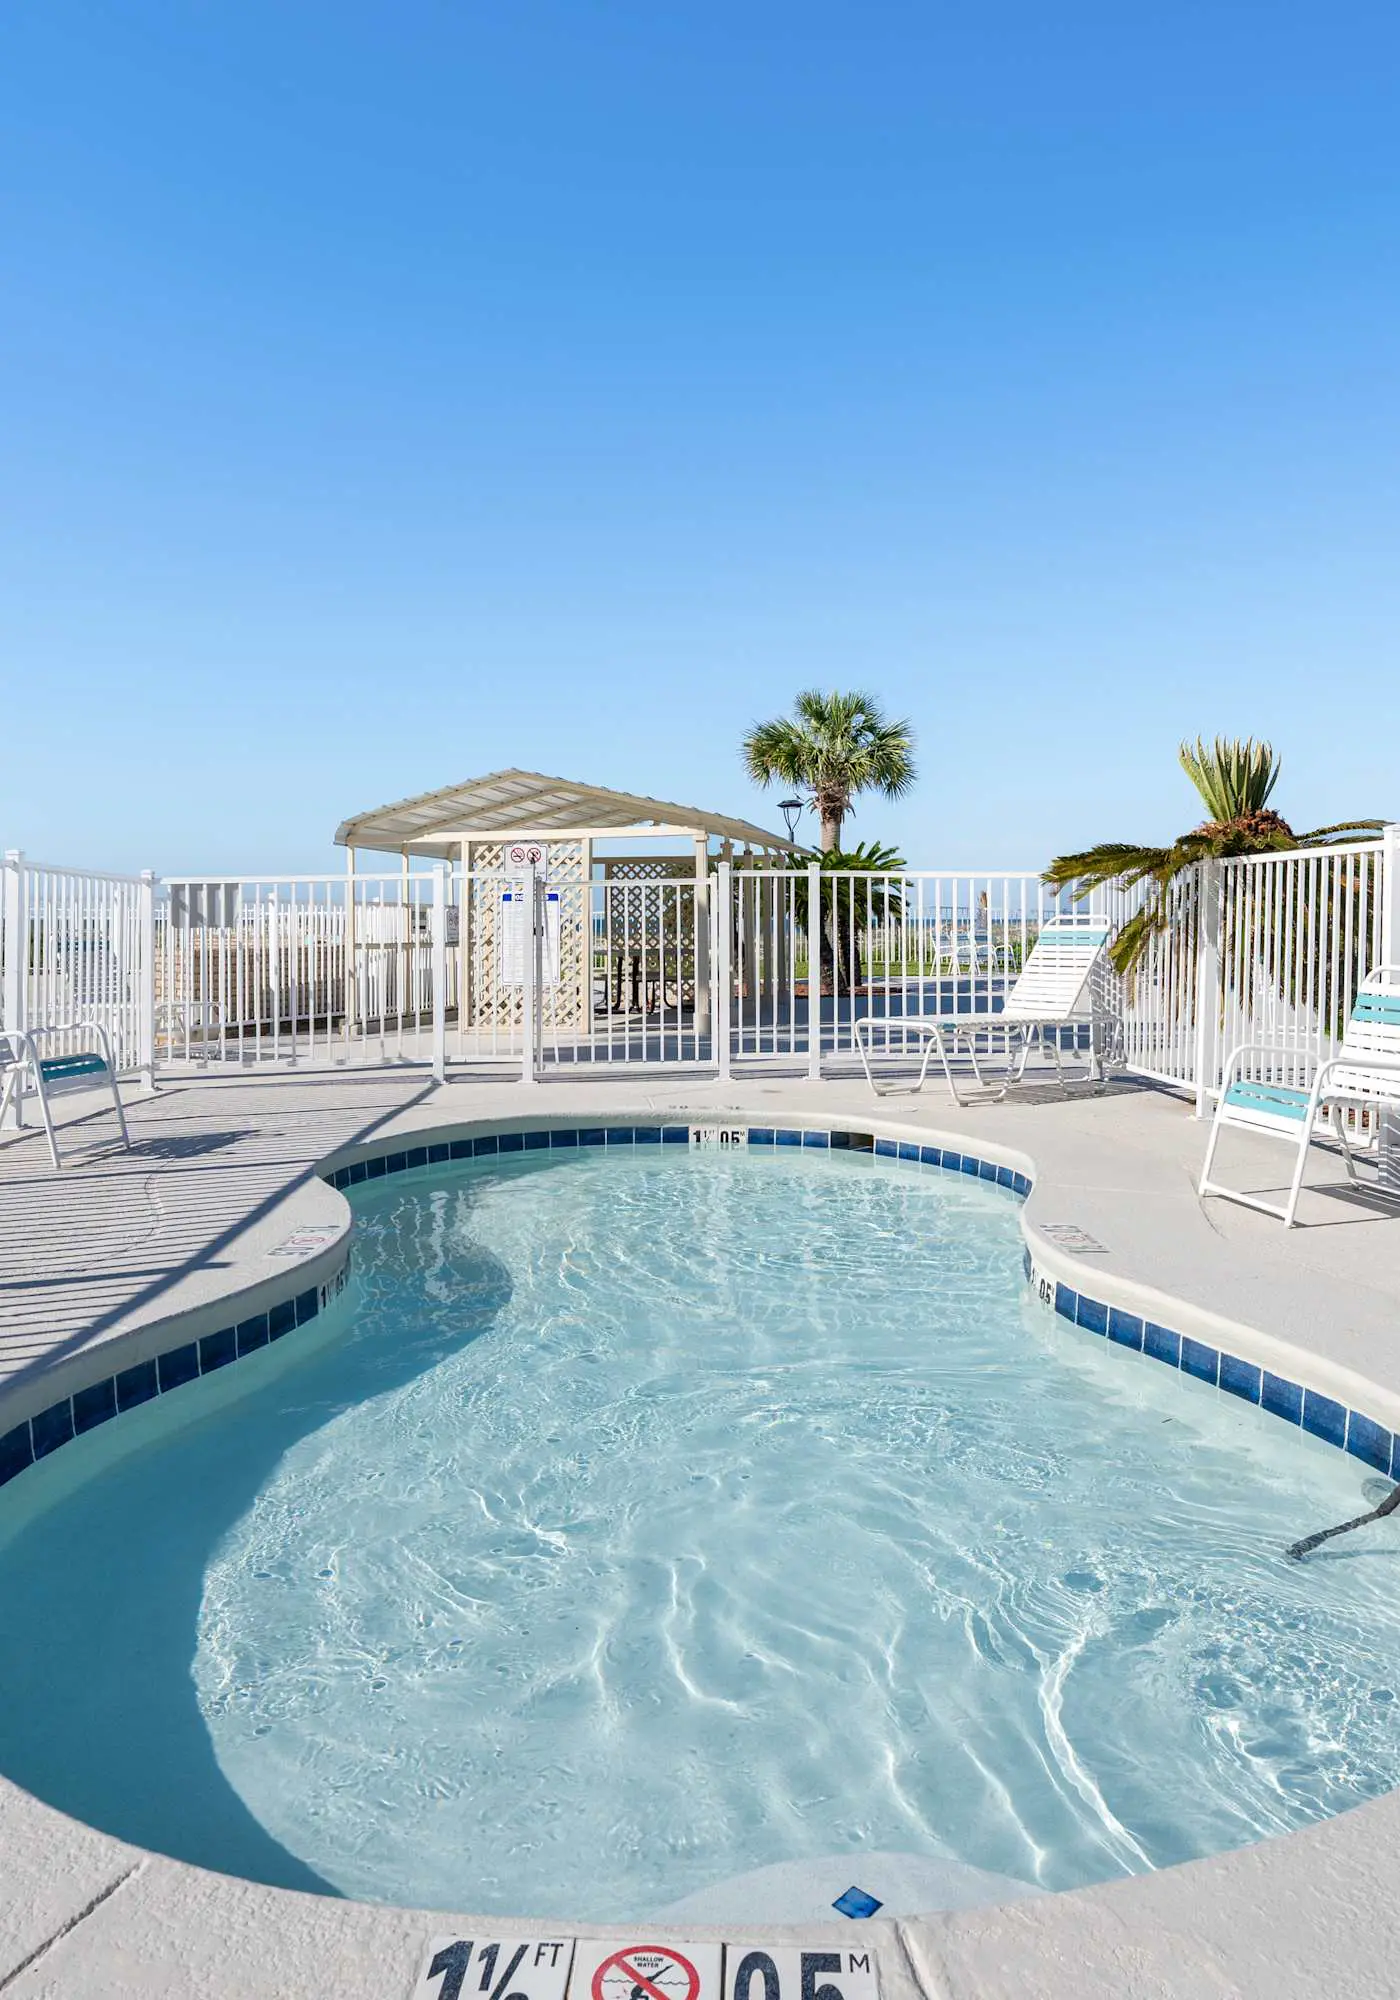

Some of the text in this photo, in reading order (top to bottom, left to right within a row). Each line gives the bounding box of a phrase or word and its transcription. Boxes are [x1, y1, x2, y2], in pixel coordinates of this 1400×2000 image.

[720, 1131, 740, 1143] 05
[1039, 1278, 1051, 1304] 05
[534, 1943, 564, 1966] FT
[734, 1951, 870, 2000] 05 M
